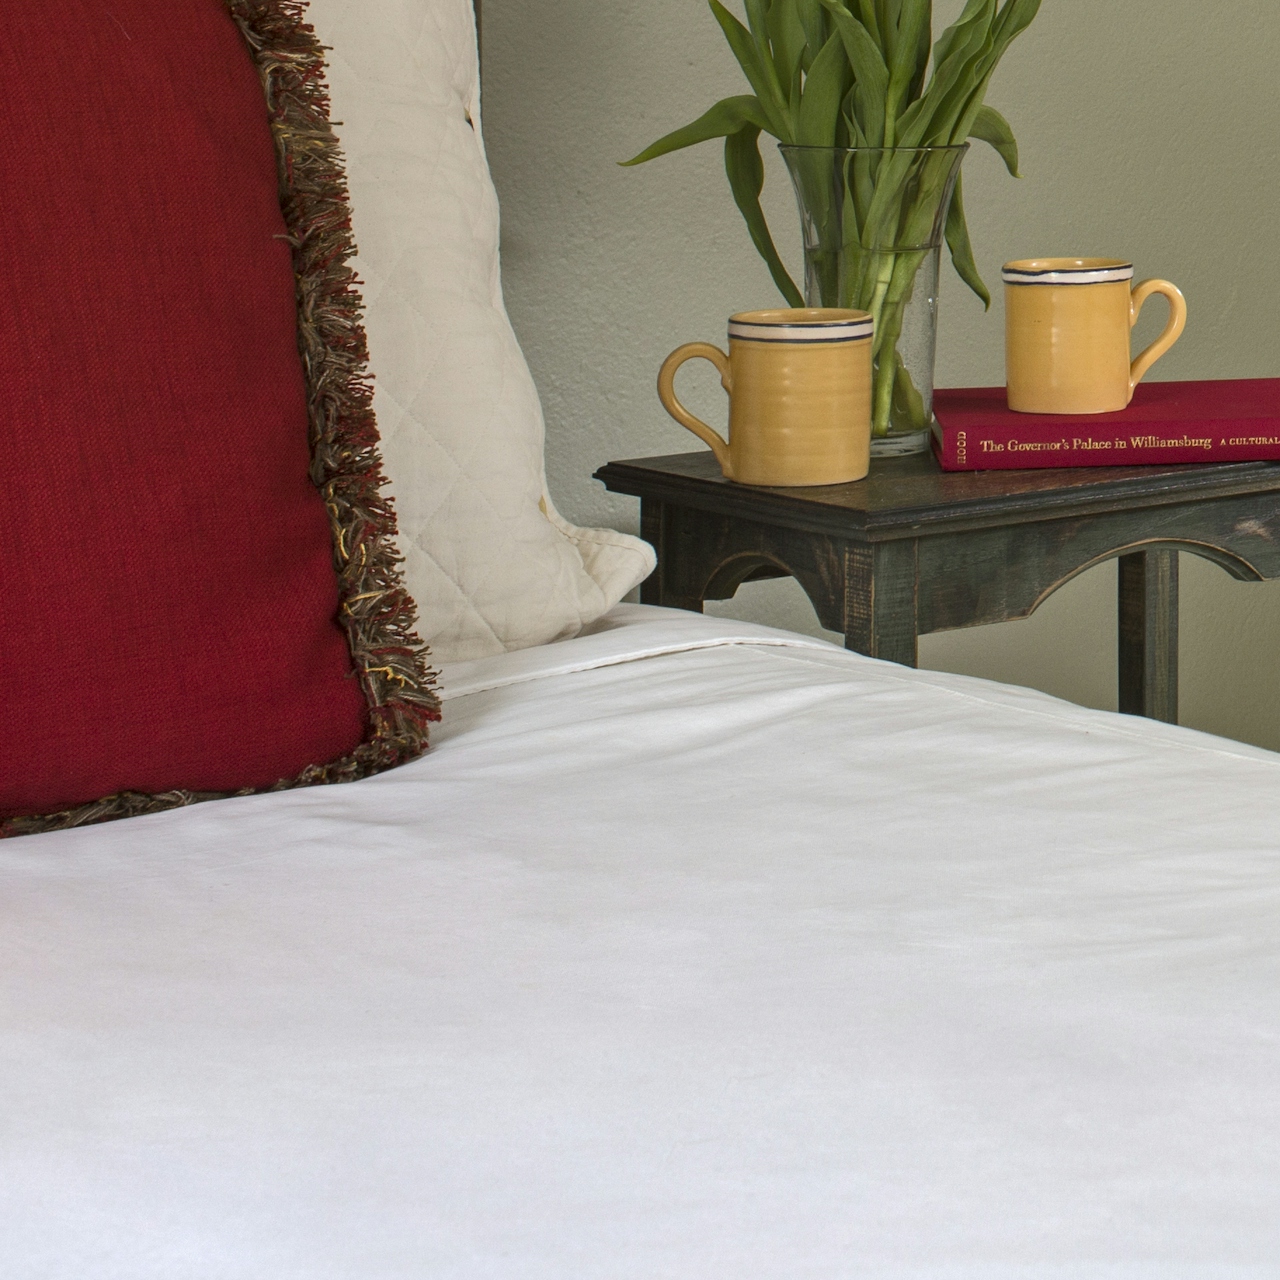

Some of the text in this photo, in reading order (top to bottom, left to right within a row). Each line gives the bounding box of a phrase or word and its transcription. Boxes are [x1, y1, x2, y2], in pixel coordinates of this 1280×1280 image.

[957, 431, 966, 464] HOOD
[979, 435, 1212, 452] The Governor's Palace in Williamsburg
[1220, 438, 1227, 446] A
[1229, 436, 1280, 446] CULTURAL
